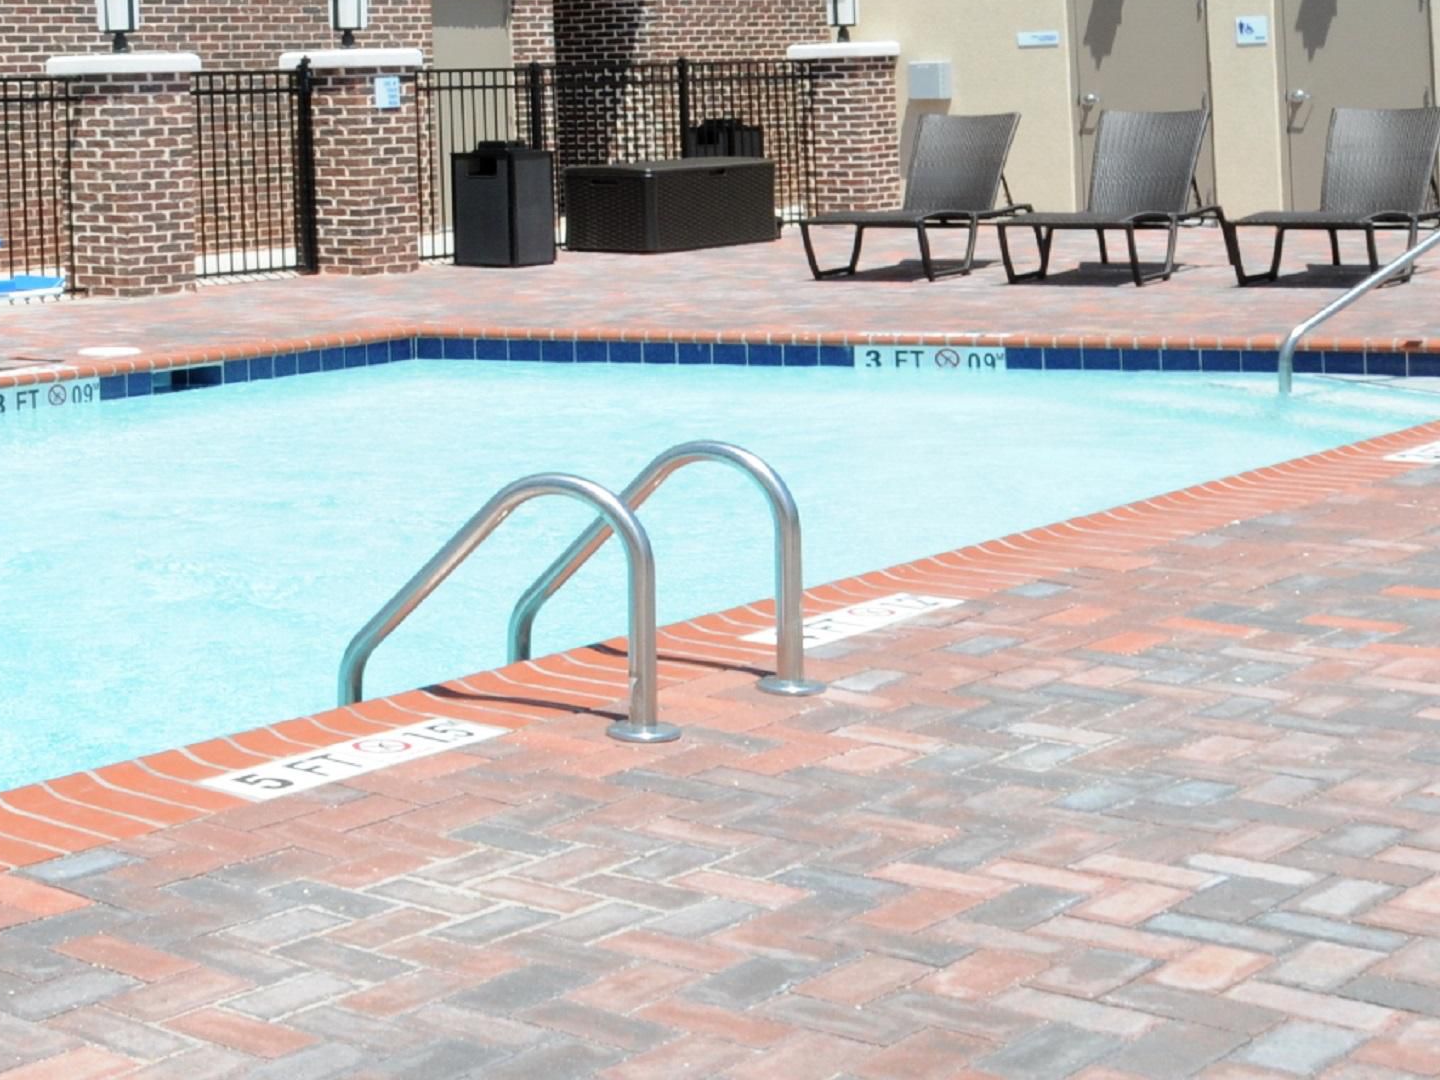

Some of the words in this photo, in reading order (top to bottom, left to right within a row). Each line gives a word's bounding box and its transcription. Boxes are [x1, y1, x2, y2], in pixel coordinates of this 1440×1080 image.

[865, 349, 883, 368] 3
[894, 350, 925, 368] FT
[15, 388, 40, 411] FT
[232, 772, 295, 790] 5
[284, 753, 364, 777] FT
